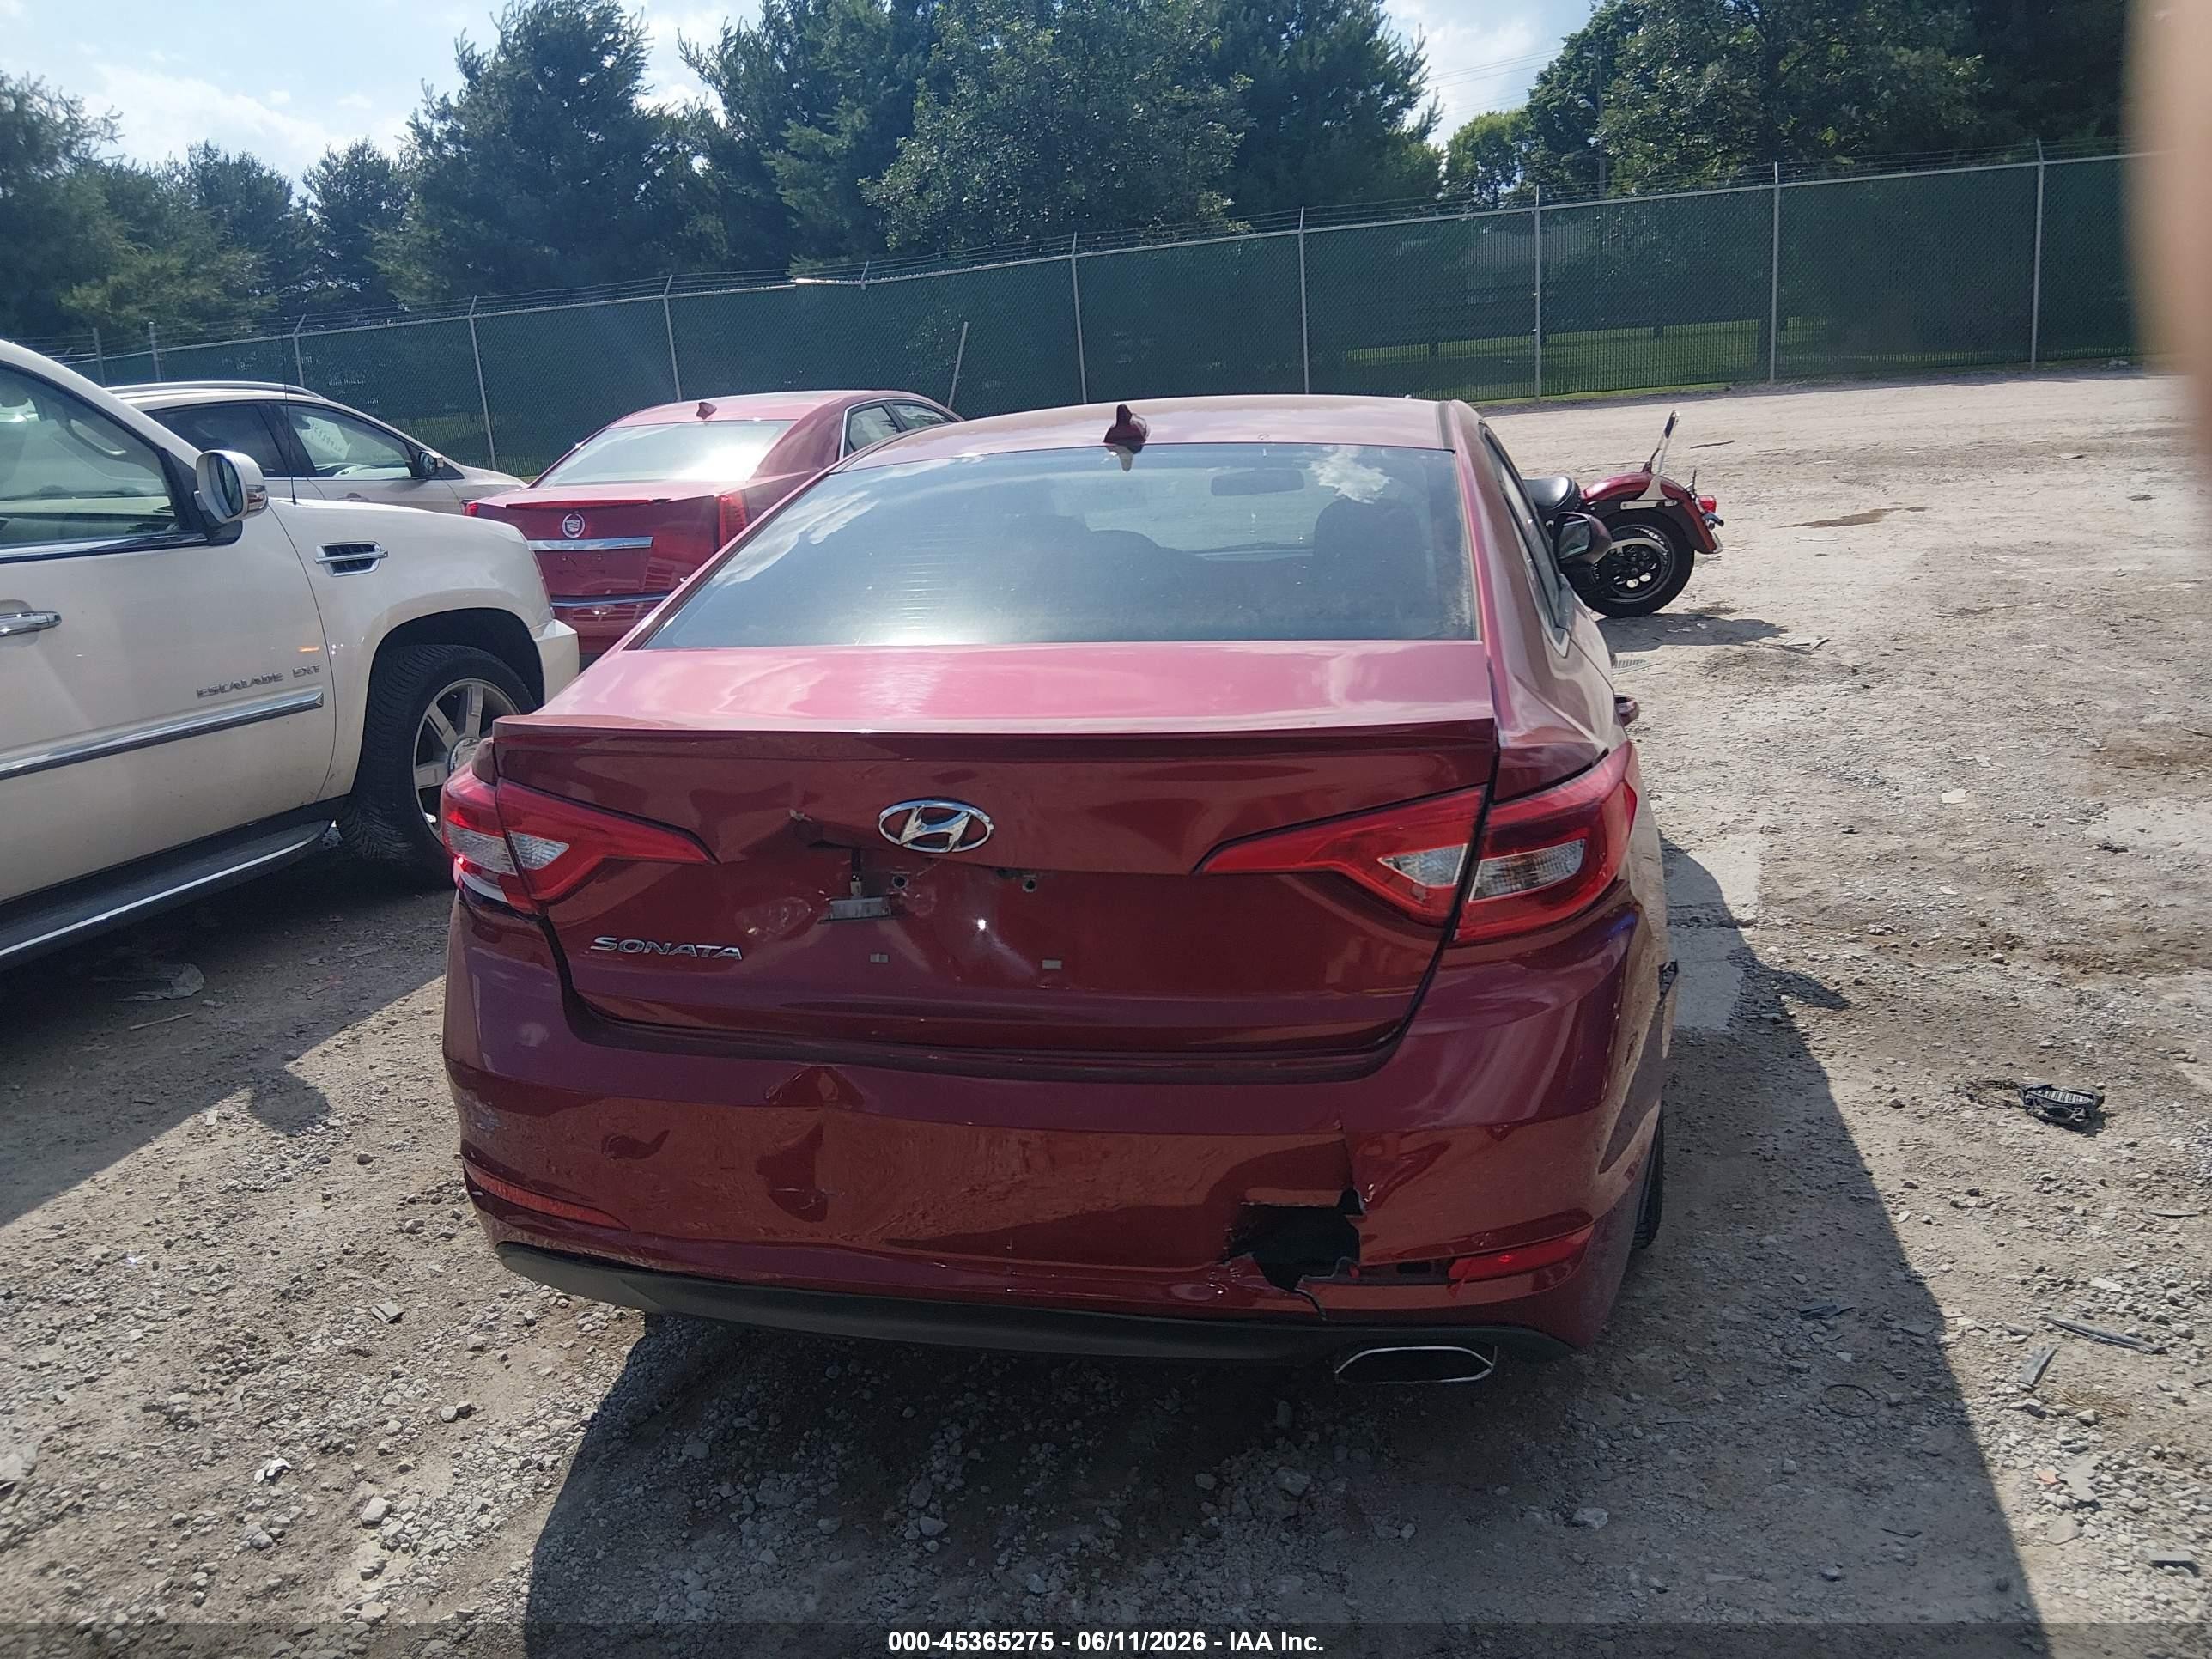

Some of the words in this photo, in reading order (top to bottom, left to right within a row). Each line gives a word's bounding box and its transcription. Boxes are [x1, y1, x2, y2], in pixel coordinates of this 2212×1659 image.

[196, 672, 283, 699] ESCALADE
[292, 665, 320, 678] EXT
[590, 937, 743, 961] SONATA
